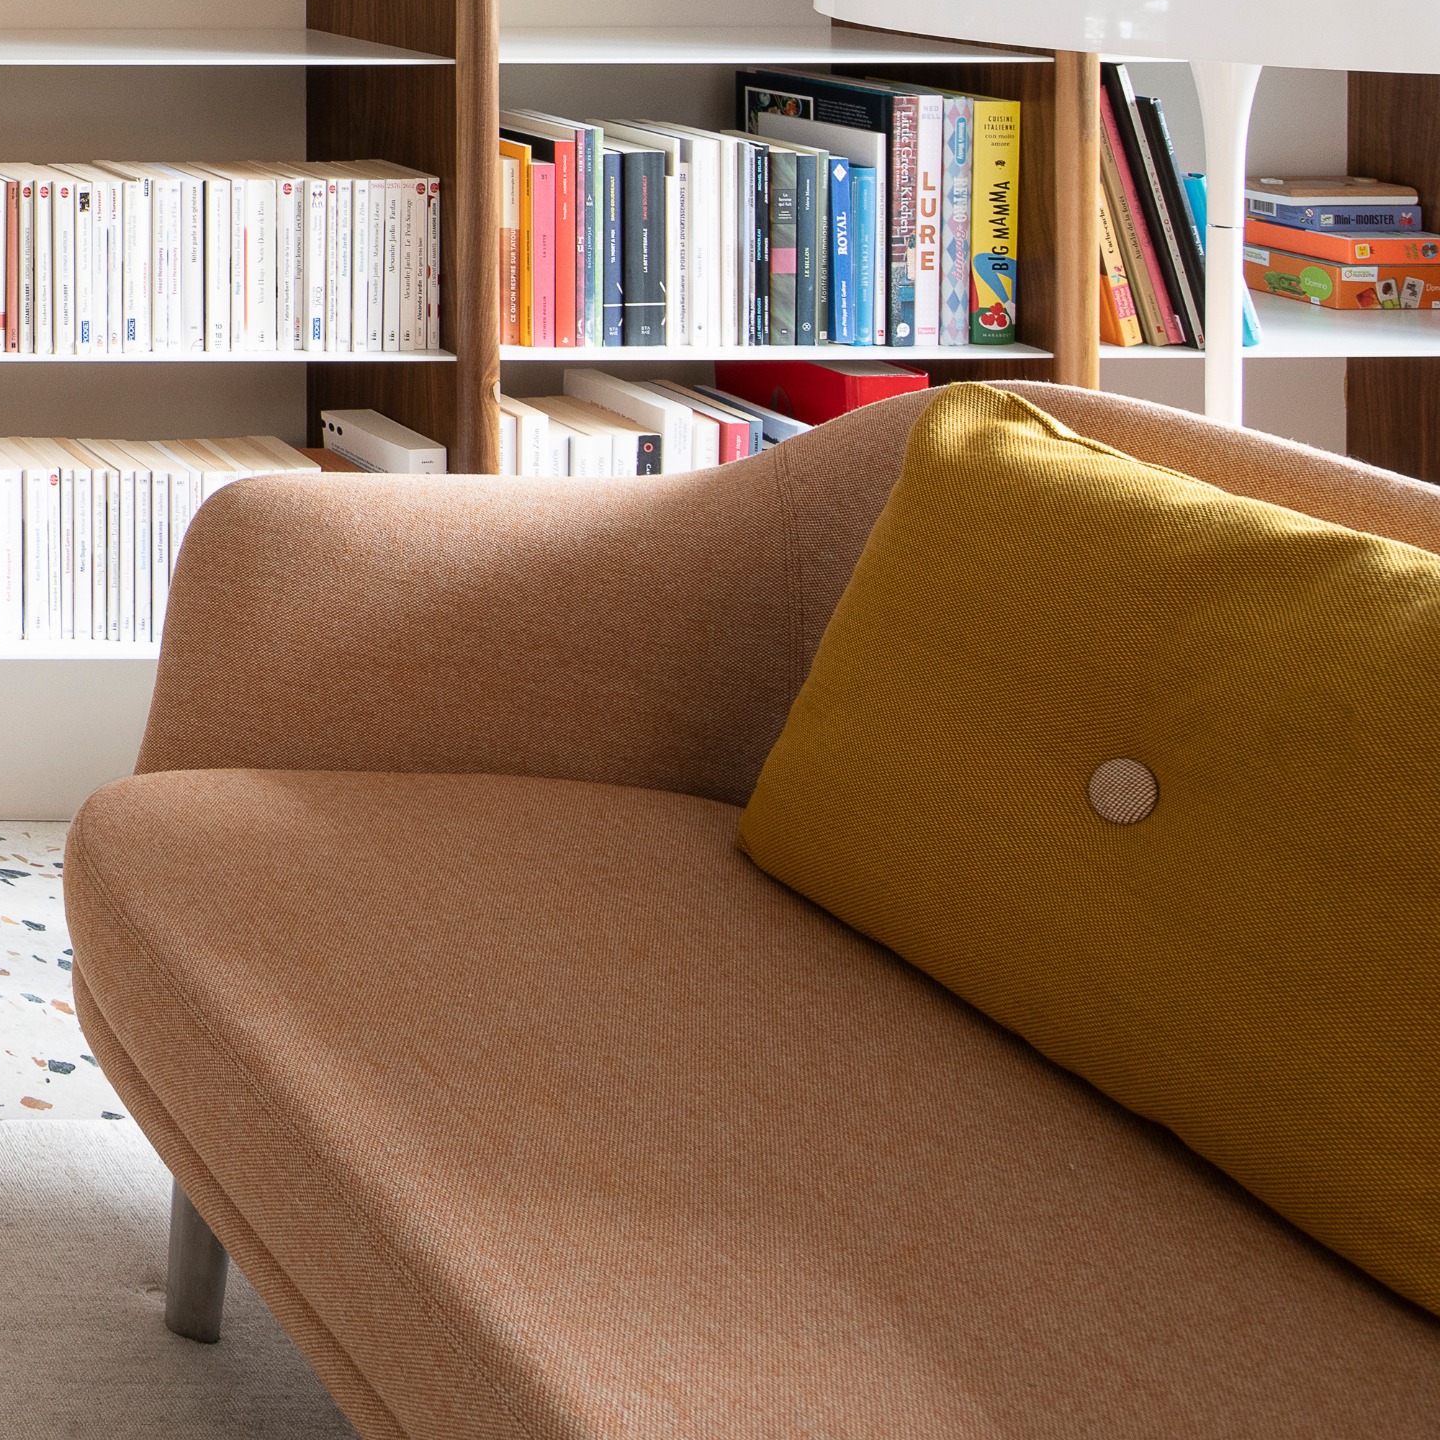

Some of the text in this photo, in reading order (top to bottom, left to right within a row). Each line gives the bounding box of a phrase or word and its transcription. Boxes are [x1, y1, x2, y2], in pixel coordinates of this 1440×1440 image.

[900, 111, 913, 233] Little Green Kitchen
[837, 211, 848, 255] ROYAL
[920, 171, 937, 271] LURE
[988, 181, 1011, 271] BIG MAMMA
[1334, 214, 1395, 224] Mini-MONSTER
[1305, 278, 1327, 290] Domino
